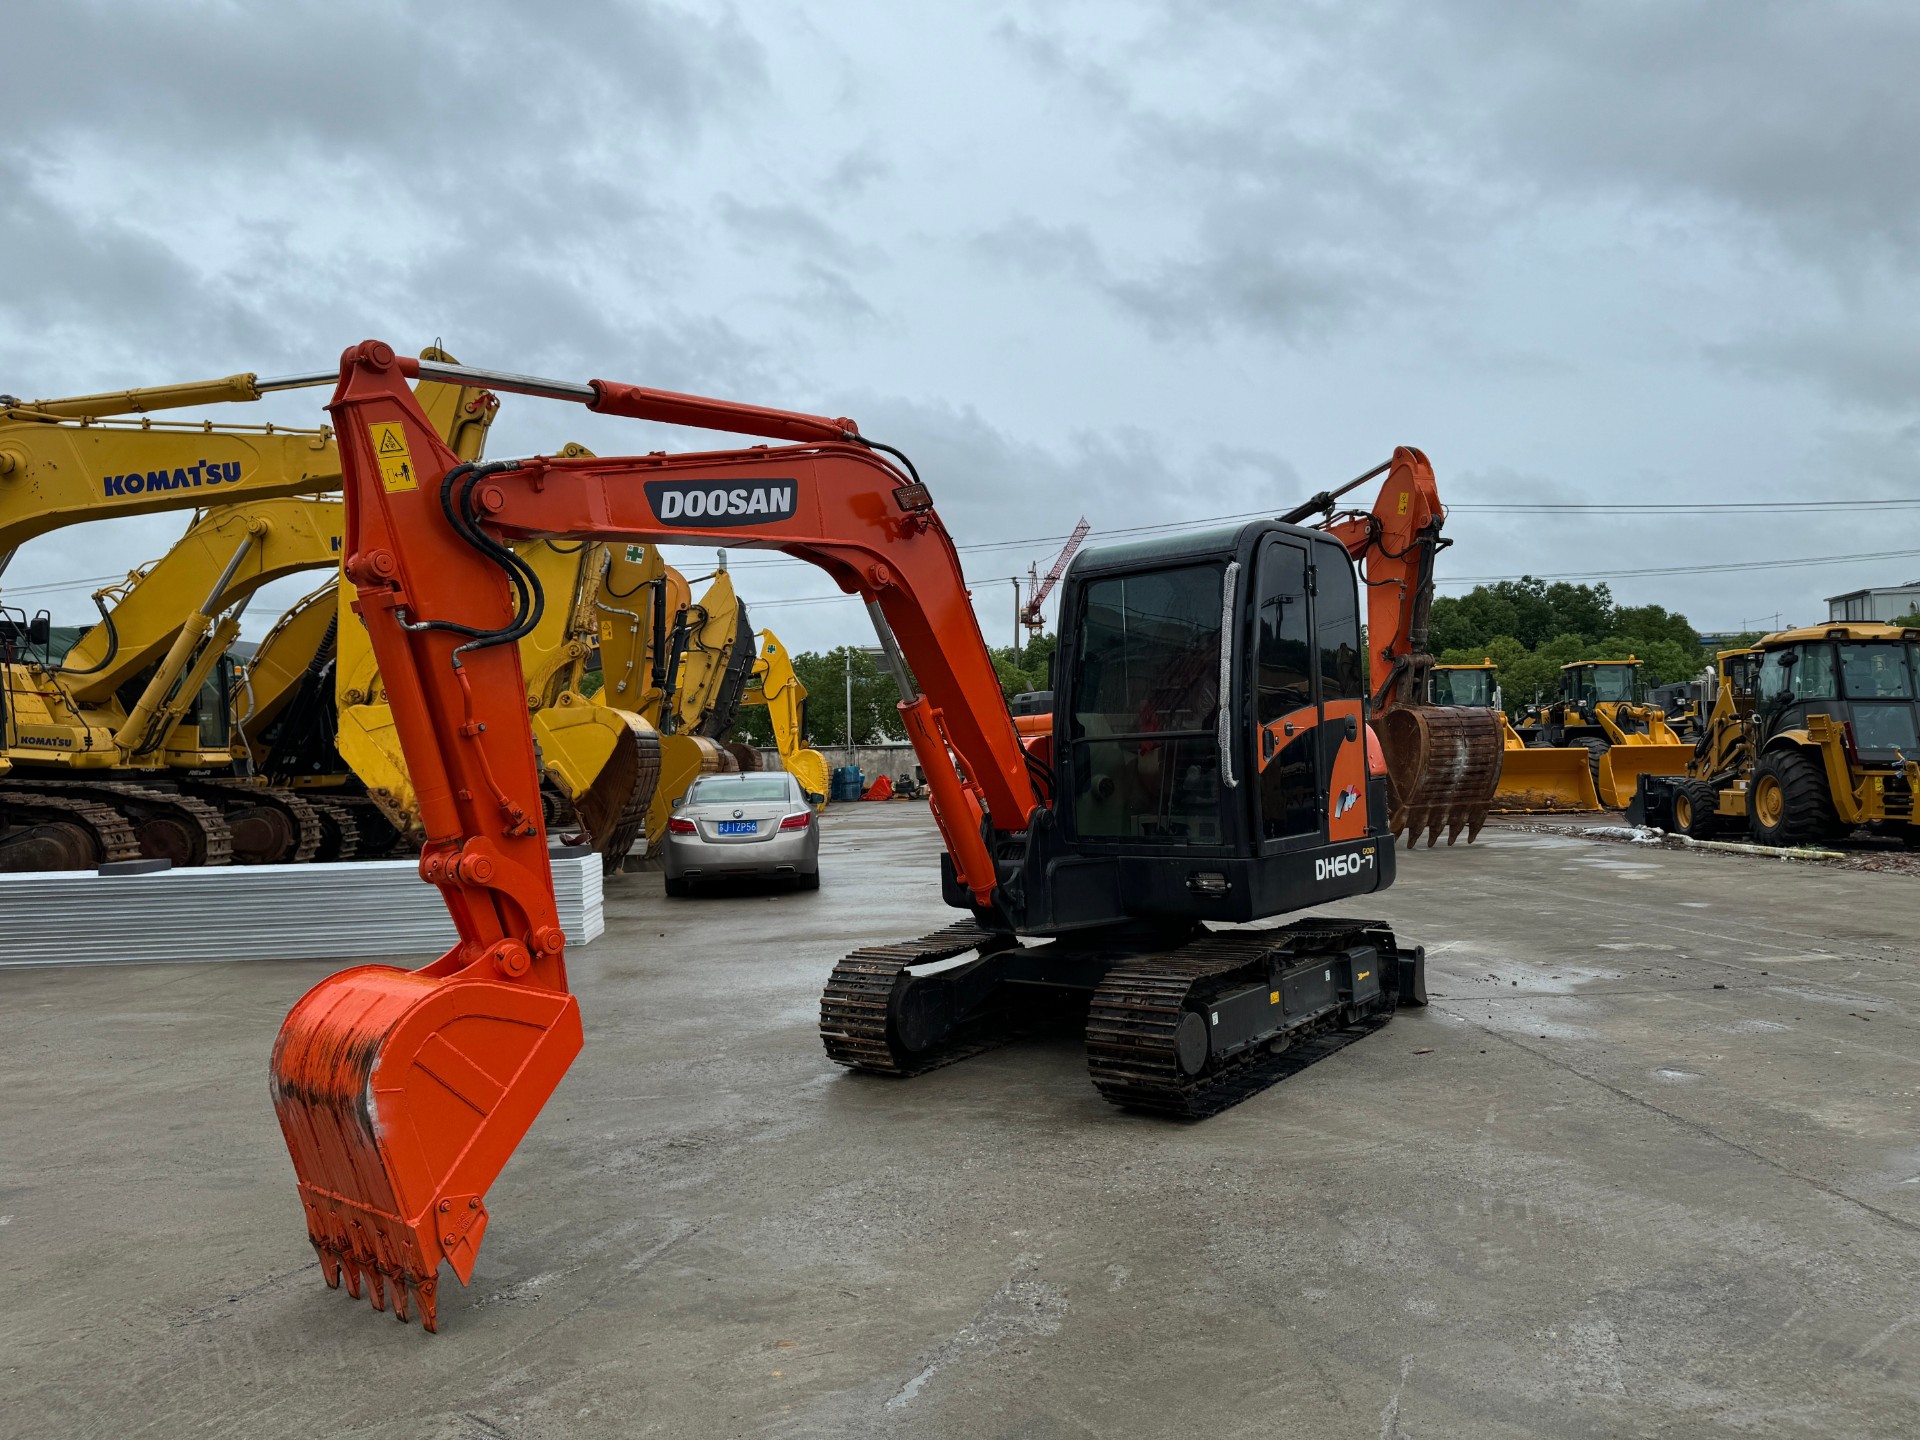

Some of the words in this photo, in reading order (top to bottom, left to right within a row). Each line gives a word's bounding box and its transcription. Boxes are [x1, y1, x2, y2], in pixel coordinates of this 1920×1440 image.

[103, 459, 242, 497] KOMATSU
[660, 486, 792, 519] DOOSAN
[21, 737, 72, 747] KOMATSU
[1315, 852, 1374, 881] DH60-7
